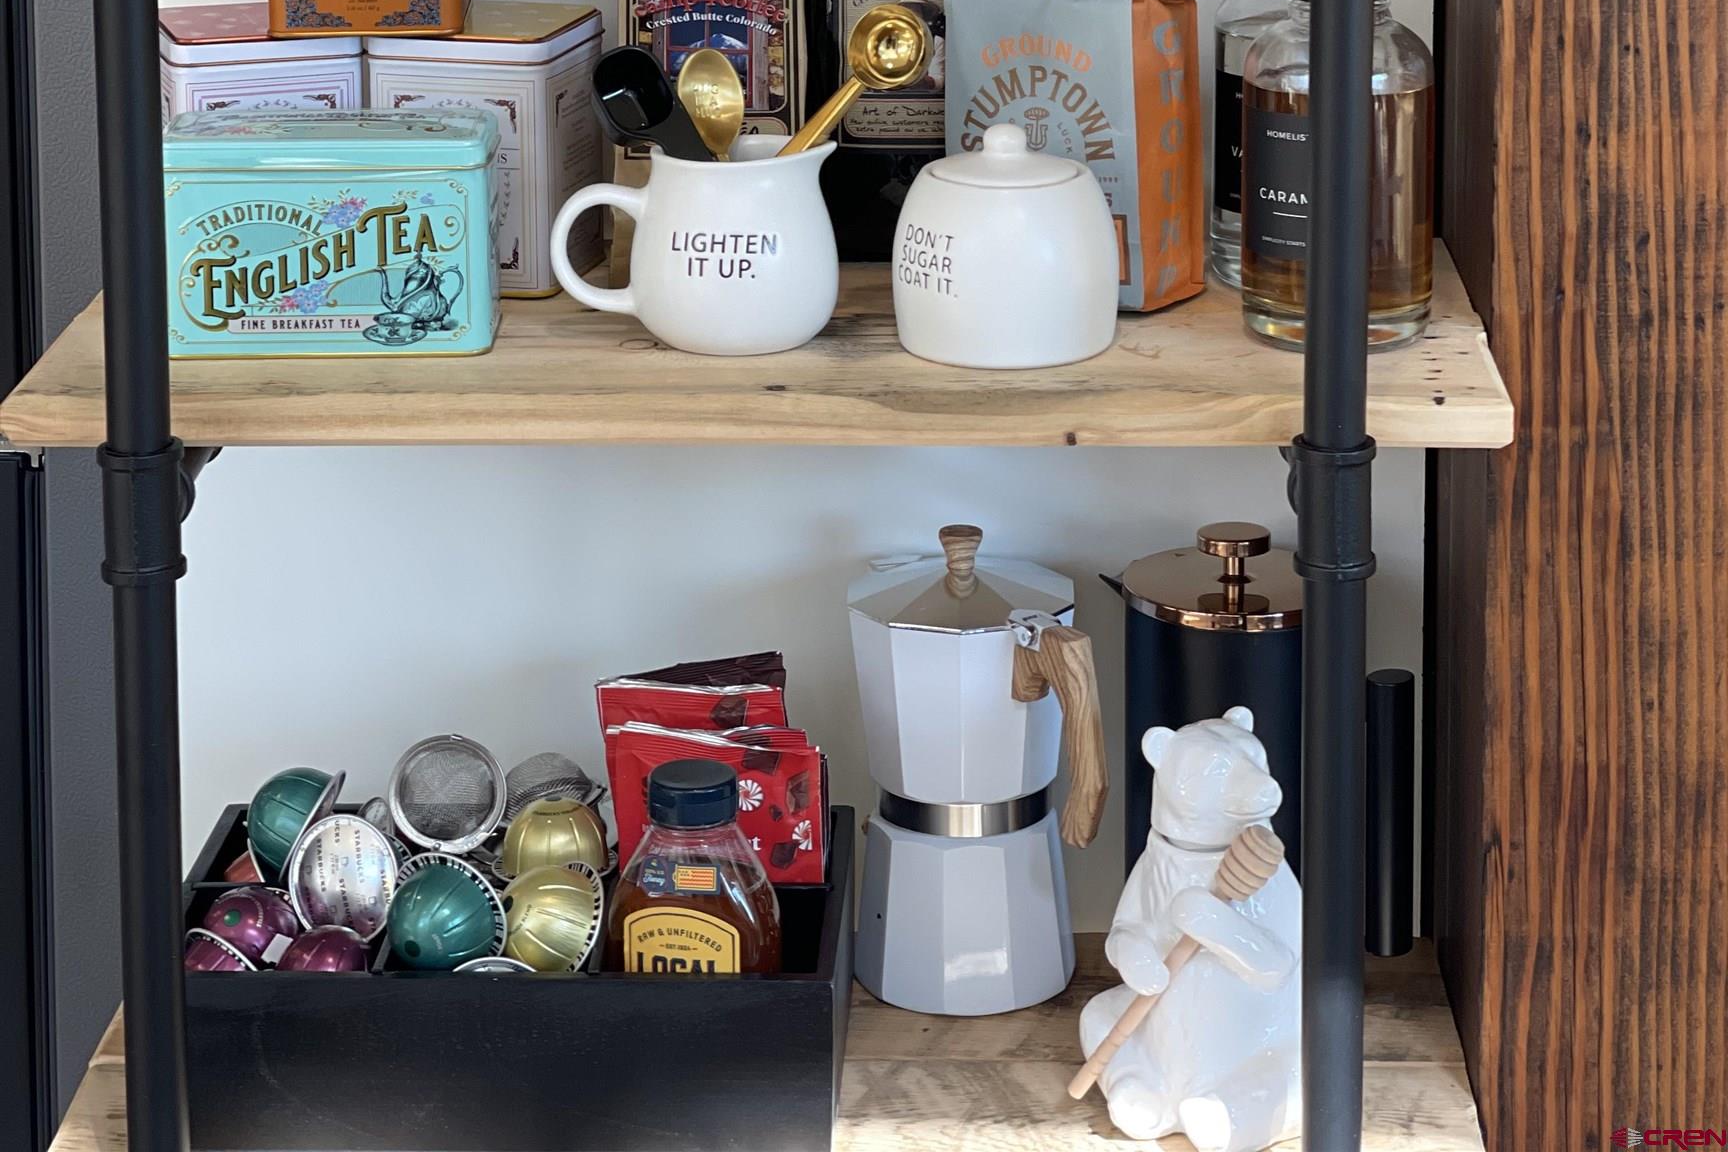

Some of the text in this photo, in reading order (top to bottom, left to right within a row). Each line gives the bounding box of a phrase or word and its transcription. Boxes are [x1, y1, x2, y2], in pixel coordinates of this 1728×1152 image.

[645, 12, 778, 37] Crested Butte Colorado
[981, 32, 1093, 73] GROUND
[961, 65, 1115, 162] STUMPTOWN
[1057, 122, 1073, 154] LUCK
[1152, 20, 1186, 297] GROUND
[196, 203, 323, 236] TRADITIONAL
[671, 231, 777, 255] LIGHTEN
[902, 244, 952, 274] SUGAR
[190, 228, 357, 320] ENGLISH
[356, 200, 439, 267] TEA
[687, 257, 755, 279] IT UP.
[898, 264, 958, 298] COAT IT.
[241, 318, 361, 330] FINE BREAKFAST TEA
[637, 928, 722, 952] RAW & UNFILTERED
